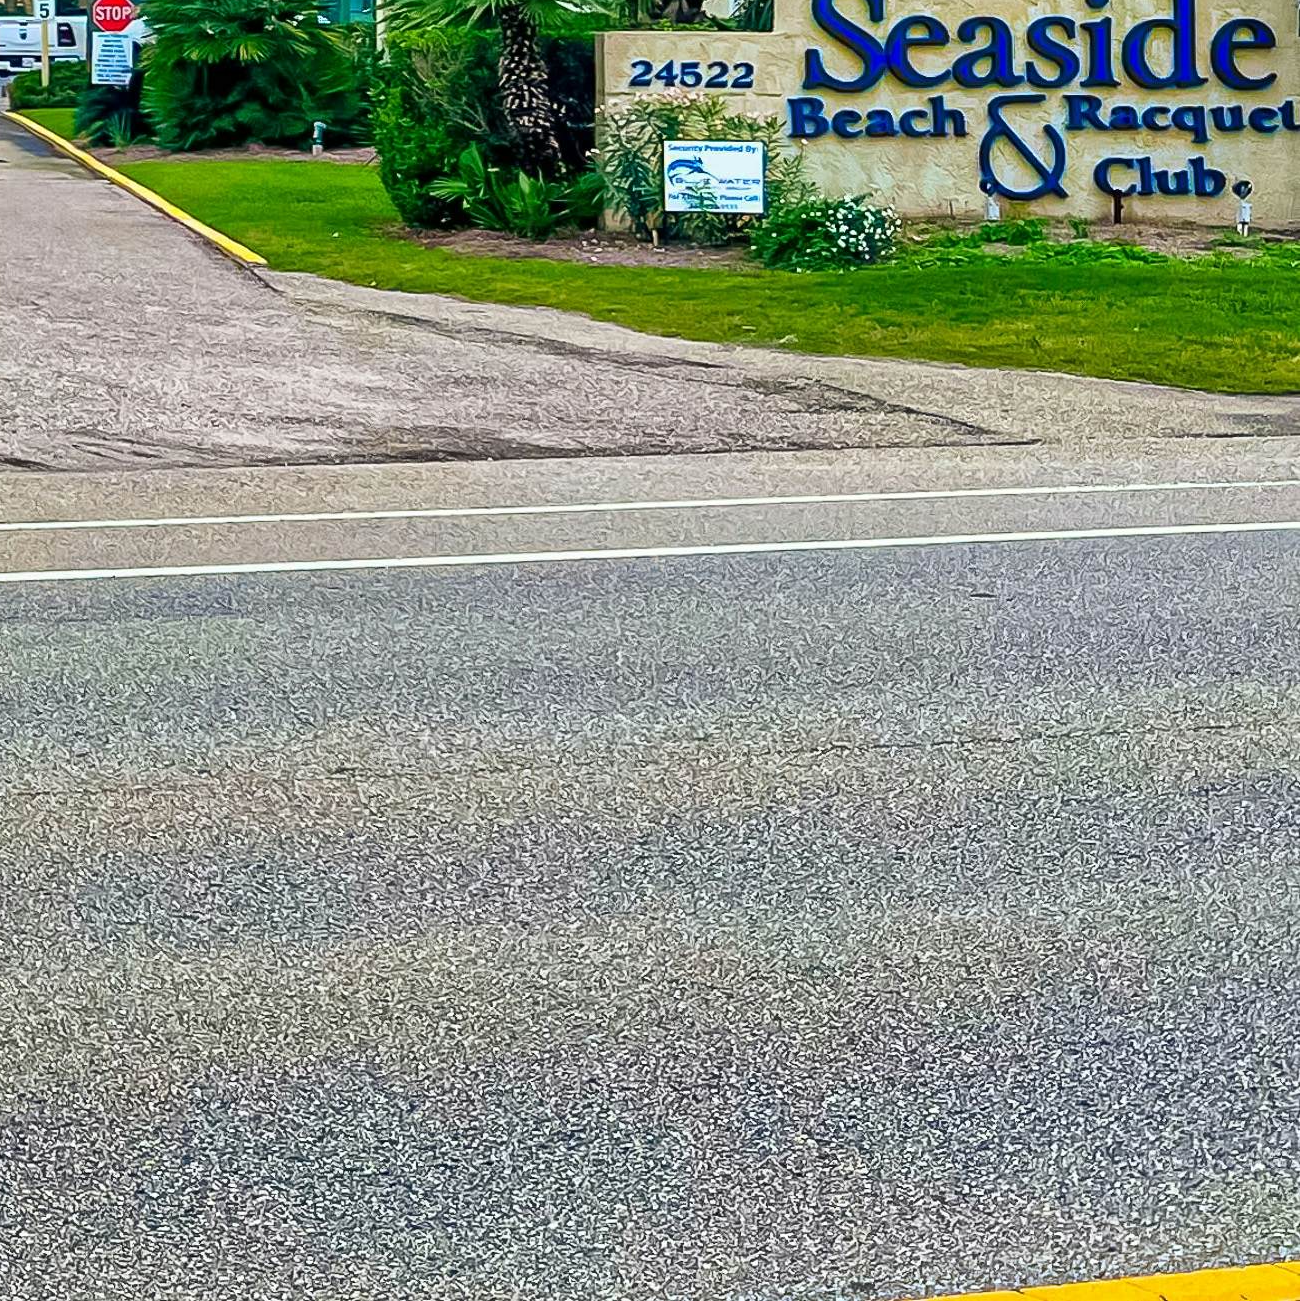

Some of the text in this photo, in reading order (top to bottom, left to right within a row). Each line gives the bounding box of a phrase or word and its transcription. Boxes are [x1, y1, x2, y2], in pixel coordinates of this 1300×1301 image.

[39, 3, 50, 19] 5
[95, 6, 132, 21] STOP
[628, 59, 754, 89] 24522
[787, 94, 1300, 201] Beach & Racquet
[1093, 156, 1227, 198] Club
